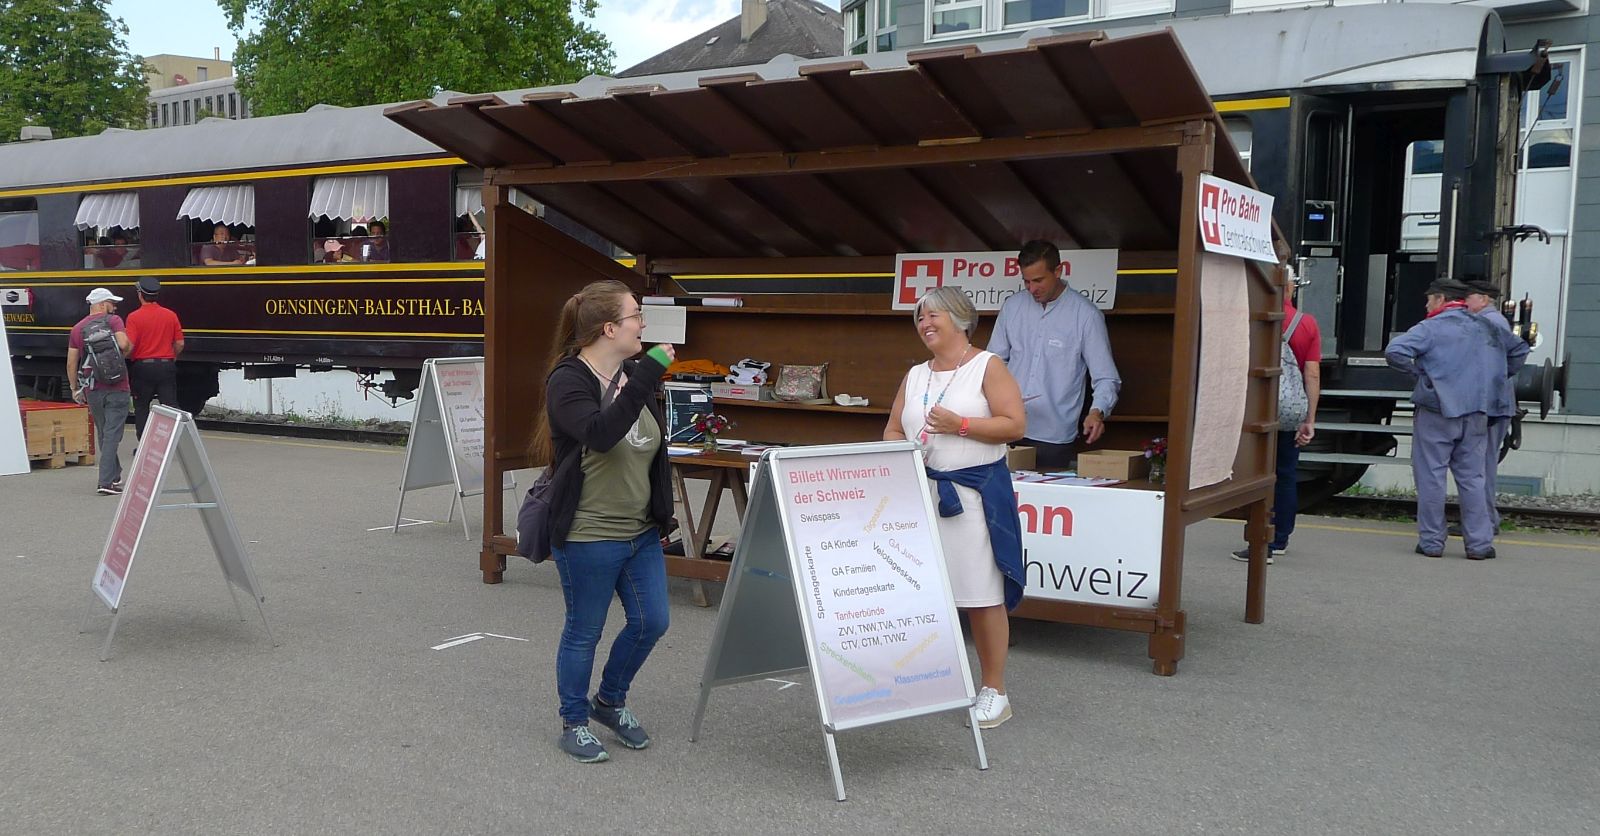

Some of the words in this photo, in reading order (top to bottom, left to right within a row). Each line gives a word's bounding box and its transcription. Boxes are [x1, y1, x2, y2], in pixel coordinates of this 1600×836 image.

[1221, 189, 1237, 216] Pro
[1238, 194, 1260, 223] Bahn
[952, 258, 995, 278] Pro
[1004, 257, 1072, 277] Bn
[265, 298, 485, 316] OENSINGEN-BALSTHAL-BA
[3, 313, 35, 323] SEWAGEN
[789, 467, 825, 485] Billett
[827, 467, 876, 483] Wirrwarr
[880, 465, 891, 480] in
[794, 492, 813, 505] der
[816, 488, 866, 503] Schweiz
[800, 511, 841, 524] Swisspass
[1013, 491, 1074, 537] hn
[882, 523, 895, 532] GA
[895, 521, 919, 531] Senior
[820, 540, 834, 551] GA
[835, 539, 859, 550] Kinder
[888, 538, 901, 552] GA
[901, 549, 923, 567] Junior
[831, 566, 844, 577] GA
[845, 563, 877, 576] Familien
[873, 541, 921, 591] Velotageskarte
[1023, 548, 1149, 600] hweiz
[805, 545, 825, 619] Spartageskarte
[832, 582, 895, 598] Kindertageskarte
[883, 632, 908, 644] TVWZ
